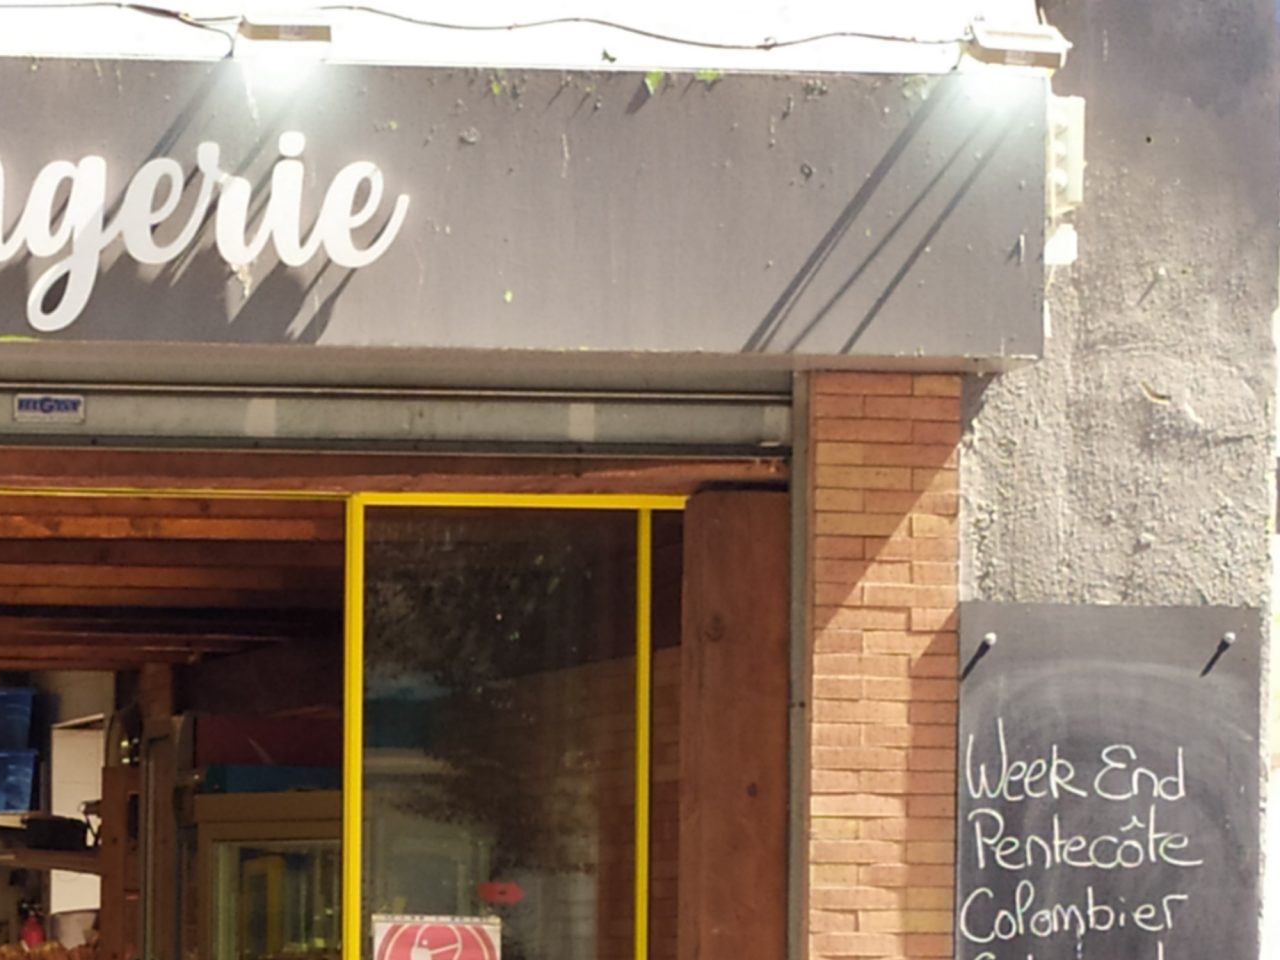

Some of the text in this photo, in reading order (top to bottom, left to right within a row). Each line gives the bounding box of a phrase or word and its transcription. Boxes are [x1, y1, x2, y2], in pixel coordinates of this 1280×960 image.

[966, 717, 1185, 801] Week End
[968, 804, 1203, 869] Pentecôte
[960, 880, 1188, 943] Colombier
